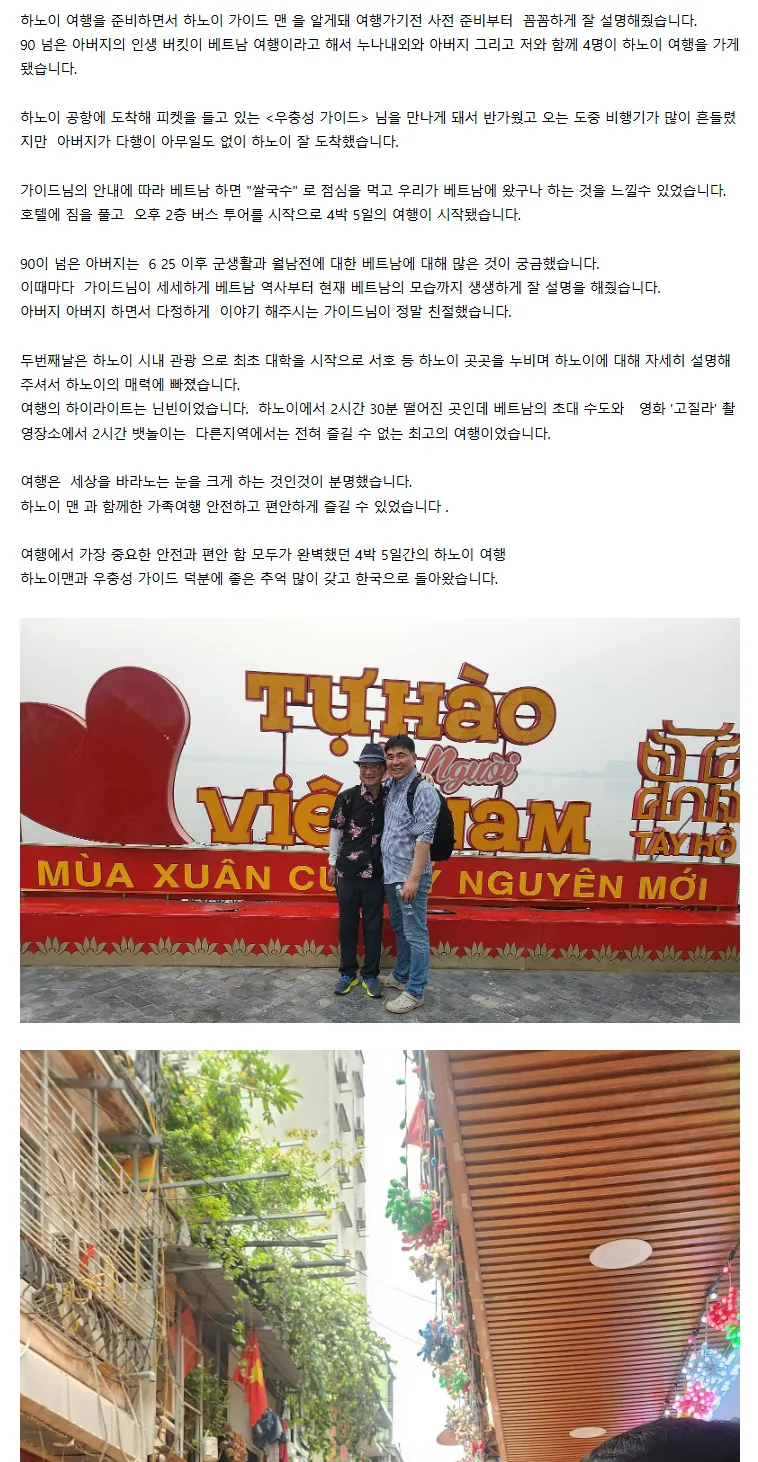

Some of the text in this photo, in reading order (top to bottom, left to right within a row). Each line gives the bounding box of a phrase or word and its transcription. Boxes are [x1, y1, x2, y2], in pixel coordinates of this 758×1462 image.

[37, 853, 134, 887] MÙA
[153, 858, 271, 891] XUÂN
[459, 867, 623, 899] NGUYÊN
[638, 868, 708, 901] MỚI
